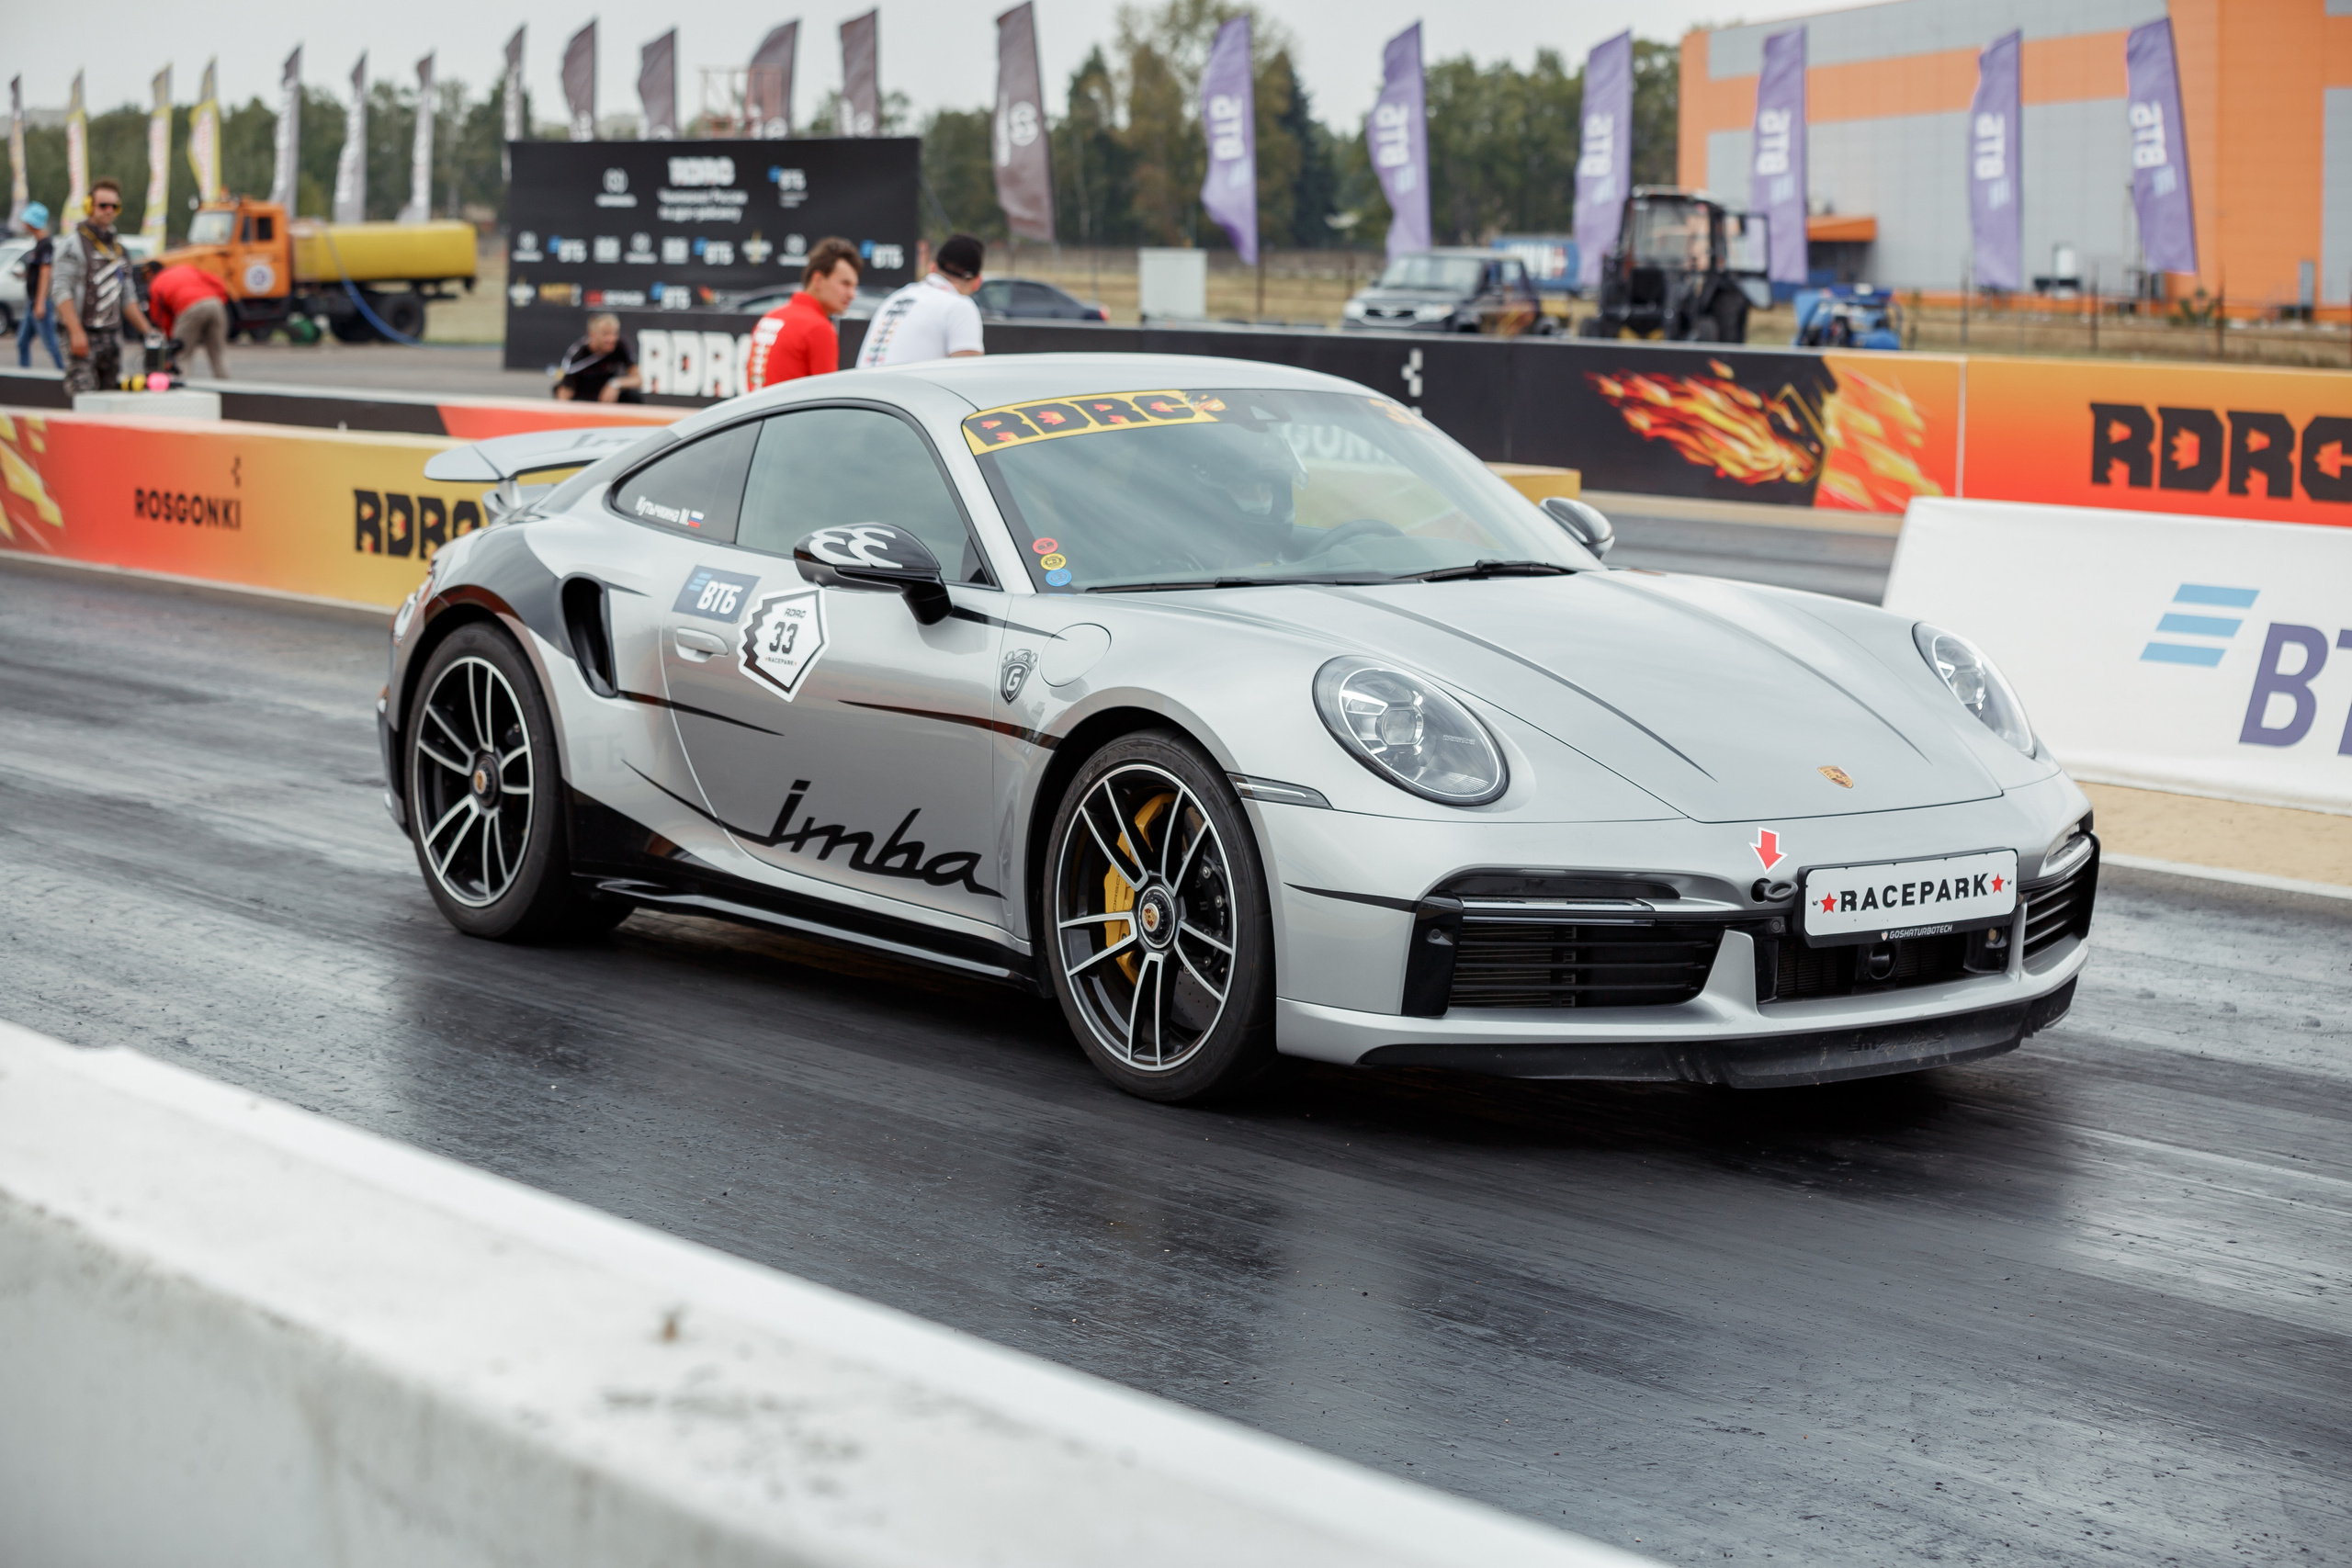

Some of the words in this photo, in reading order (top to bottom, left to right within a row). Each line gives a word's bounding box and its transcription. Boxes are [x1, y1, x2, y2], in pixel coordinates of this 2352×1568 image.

[963, 394, 1196, 447] RDRC
[134, 488, 242, 531] ROSGONKI
[769, 621, 798, 654] 33
[1840, 873, 1988, 913] RACEPARK
[1889, 924, 1953, 939] GOSHATURBOTECH
